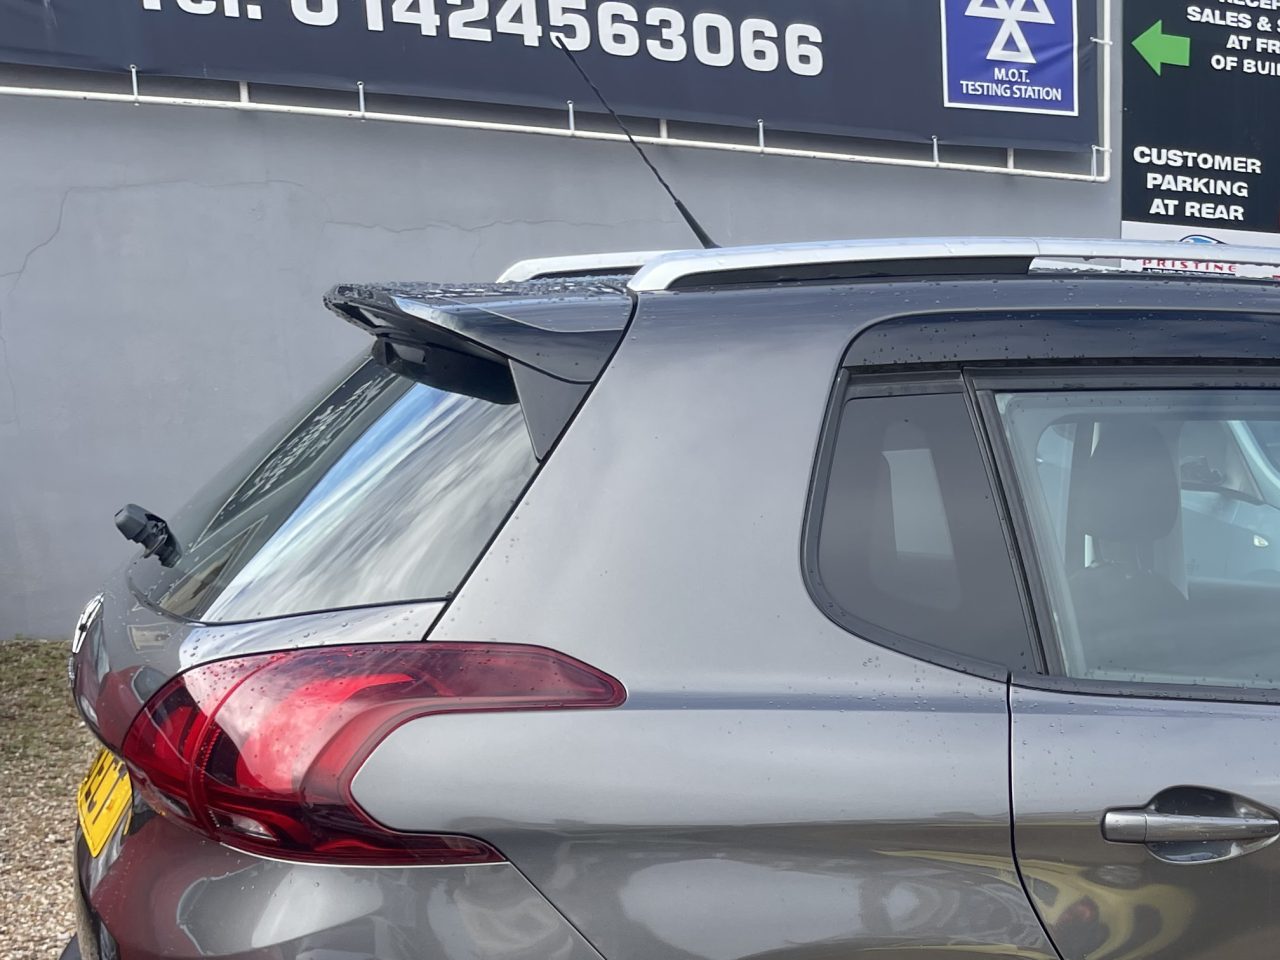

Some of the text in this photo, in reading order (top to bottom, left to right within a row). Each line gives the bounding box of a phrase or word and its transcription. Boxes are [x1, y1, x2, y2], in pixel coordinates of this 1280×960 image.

[1186, 6, 1252, 28] SALES
[1256, 16, 1272, 32] &
[1226, 34, 1251, 50] AT
[1210, 54, 1238, 71] OF
[993, 67, 1031, 84] M.O.T.
[960, 80, 1062, 101] TESTING STATION
[1133, 145, 1262, 174] CUSTOMER
[1146, 172, 1249, 197] PARKING
[1149, 198, 1244, 221] AT REAR
[1142, 259, 1237, 272] PRISTINE
